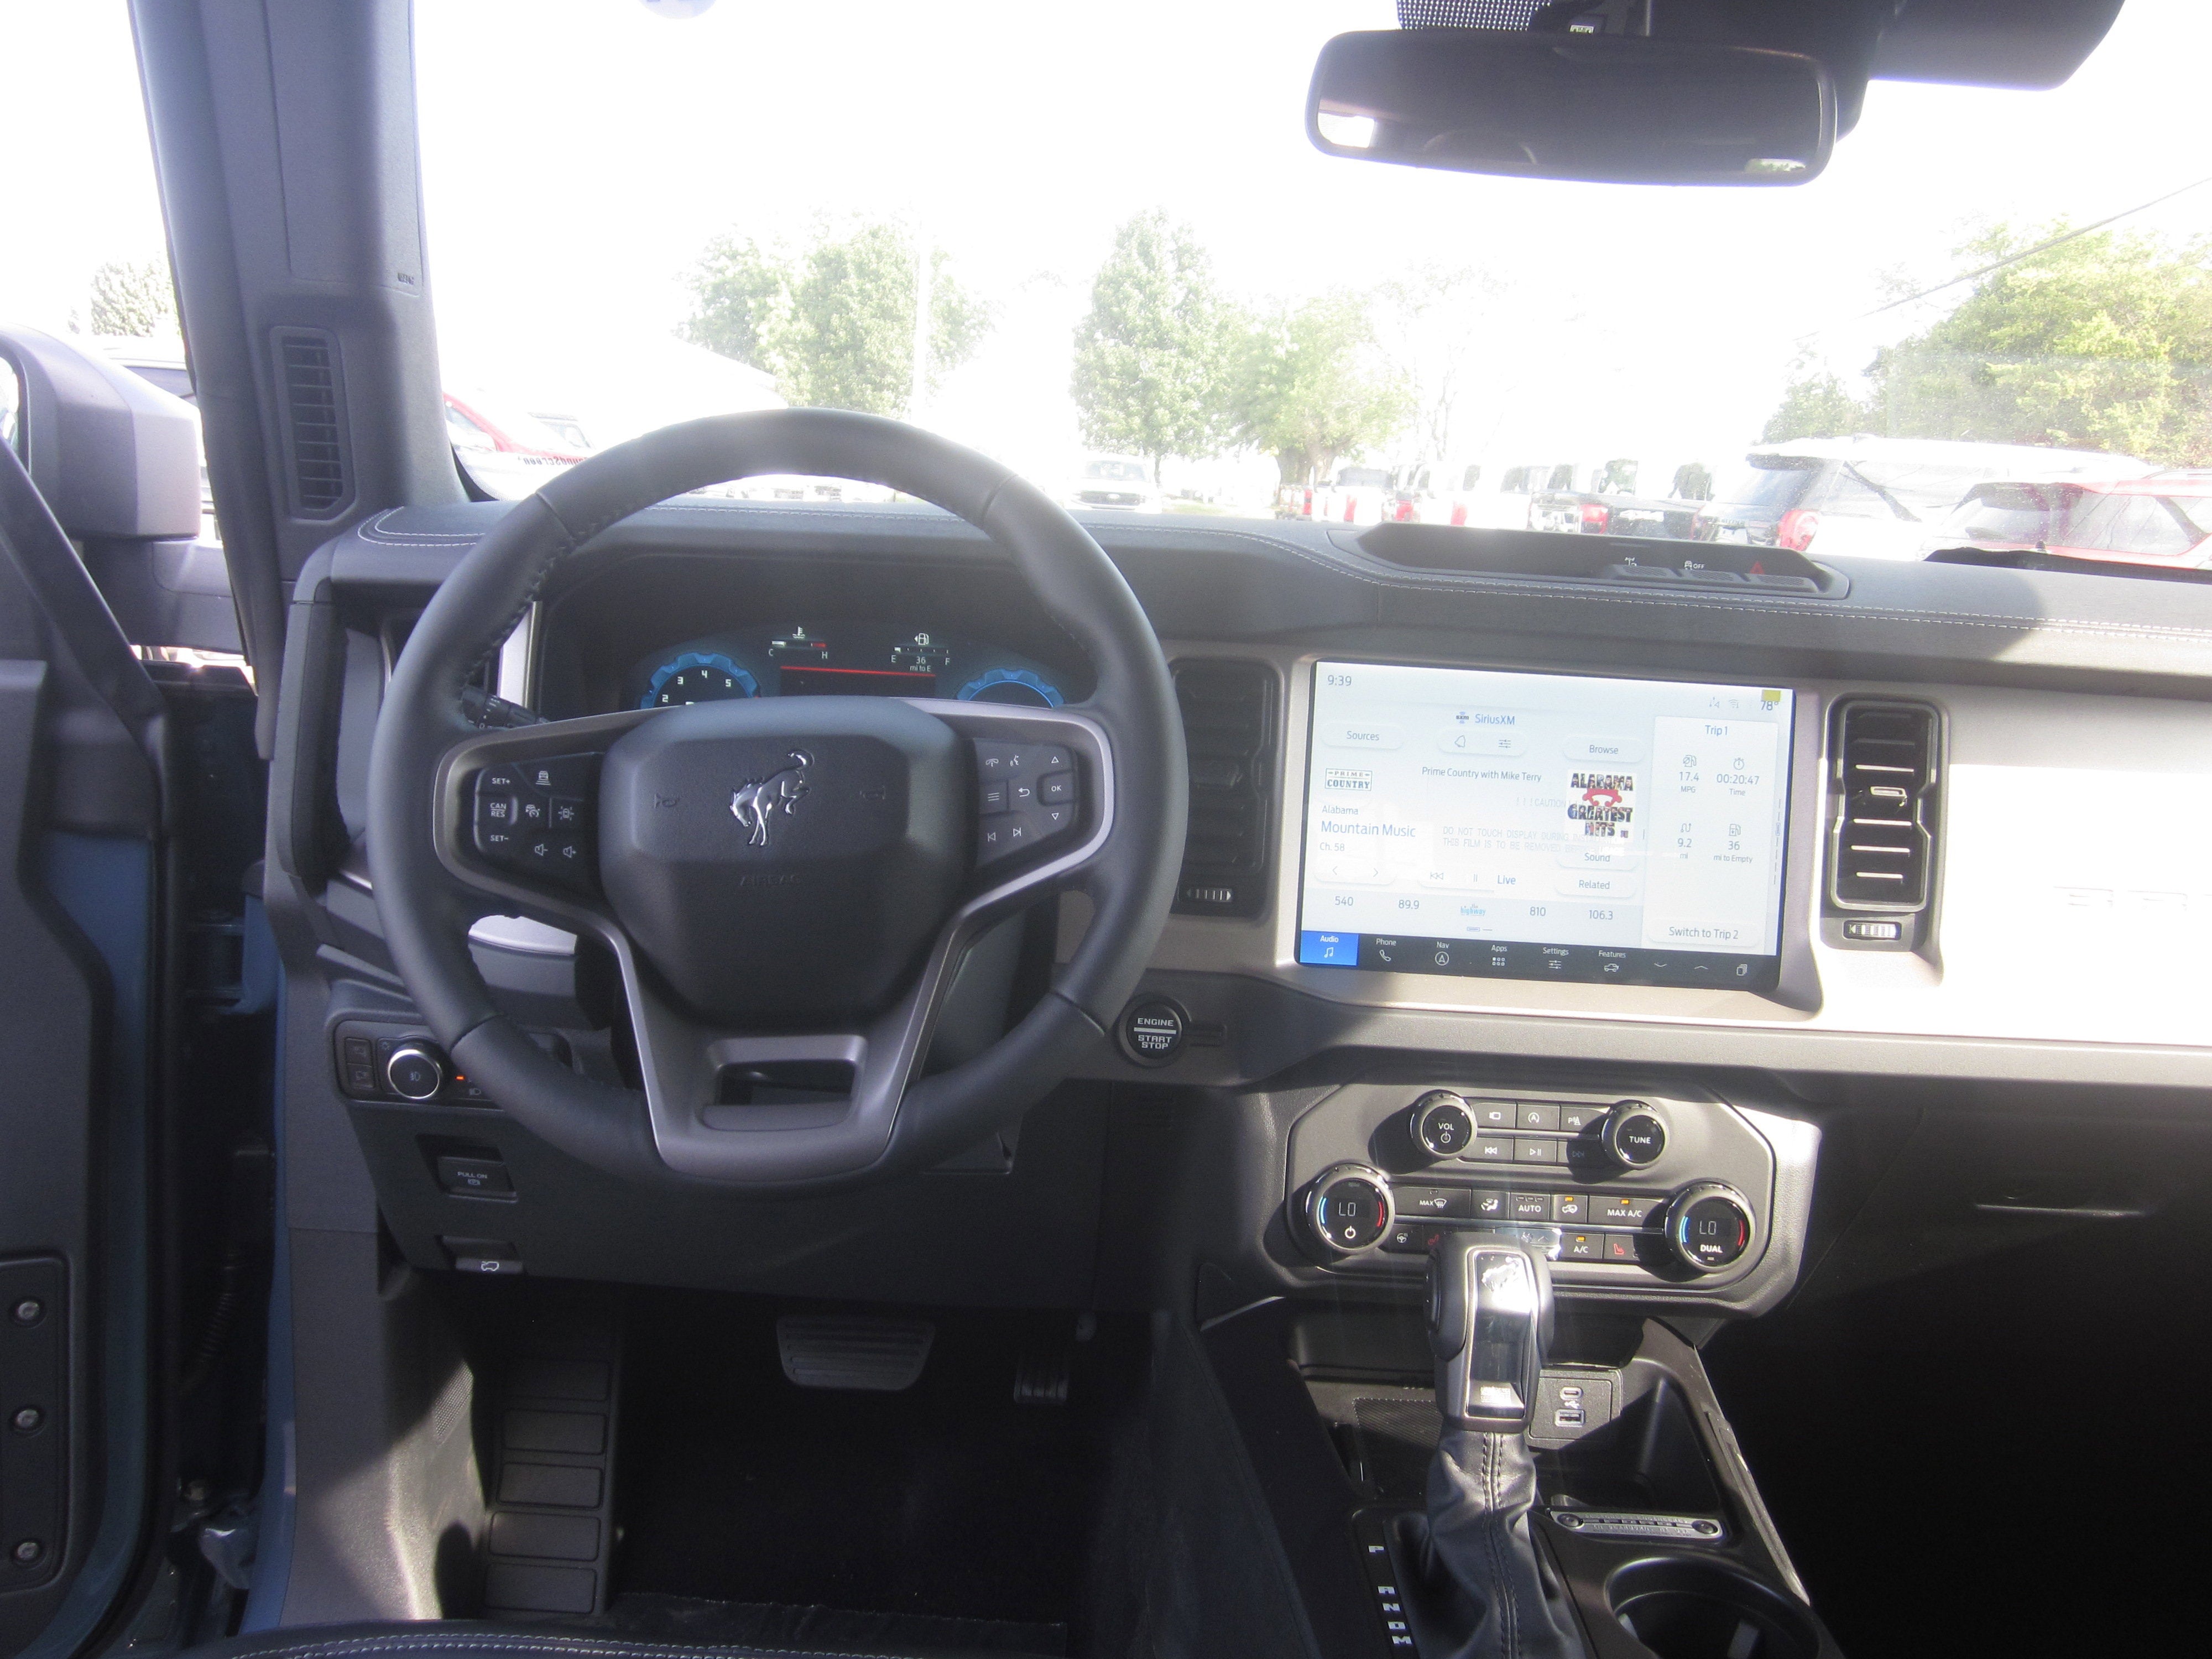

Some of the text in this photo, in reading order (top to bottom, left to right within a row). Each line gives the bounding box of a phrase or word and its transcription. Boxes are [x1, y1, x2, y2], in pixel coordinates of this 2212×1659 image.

[891, 655, 896, 663] E
[701, 670, 708, 679] 4
[677, 677, 684, 685] 3
[1327, 675, 1352, 686] 9:39
[661, 695, 669, 703] 2
[1475, 713, 1516, 725] SiriusXM
[1705, 725, 1728, 736] Trip 1
[1346, 731, 1380, 742] Sources
[1589, 744, 1619, 755] Browse
[1422, 766, 1542, 783] Prime Country with Mike Terry
[1679, 772, 1700, 782] 17.4
[1716, 774, 1760, 785] 00:20:47
[1327, 779, 1370, 790] COUNTRY
[1571, 773, 1634, 791] ALABAMA
[1322, 805, 1359, 816] Alabama
[1567, 804, 1634, 822] GREATEST
[1321, 821, 1416, 838] Mountain Music
[1443, 826, 1454, 835] DO
[1458, 827, 1474, 836] NOT
[1477, 828, 1503, 838] TOUCH
[1506, 830, 1537, 839] DISPLAY
[1319, 842, 1345, 852] Ch. 58
[1443, 837, 1459, 847] THIS
[1463, 838, 1480, 848] FILM
[1484, 839, 1491, 848] IS
[1496, 840, 1506, 849] TO
[1510, 841, 1521, 851] BE
[1524, 842, 1561, 852] REMOVED
[1677, 838, 1692, 848] 9.2
[1728, 841, 1740, 851] 36
[1584, 853, 1611, 863] Sound
[1731, 855, 1753, 864] Empty
[1497, 875, 1516, 885] Live
[1578, 880, 1610, 890] Related
[1334, 896, 1354, 906] 540
[1398, 900, 1420, 910] 89.9
[1530, 906, 1547, 917] 810
[1589, 910, 1614, 920] 106.3
[1668, 926, 1739, 941] Switch to Trip 2
[1320, 935, 1339, 943] Audio
[1376, 938, 1397, 947] Phone
[1437, 942, 1449, 950] Nav
[1491, 945, 1507, 953] Apps
[1542, 947, 1569, 957] Settings
[1598, 950, 1626, 959] Features
[1137, 1018, 1173, 1026] ENGINE
[1138, 1035, 1172, 1043] START
[1438, 1123, 1454, 1131] VOL
[1629, 1136, 1652, 1145] TUNE
[1518, 1204, 1542, 1213] AUTO
[1607, 1209, 1642, 1218] MAX A/C
[1573, 1245, 1589, 1254] A/C
[1700, 1244, 1723, 1254] DUAL
[1368, 1545, 1385, 1553] P
[1383, 1603, 1401, 1612] N
[1387, 1621, 1406, 1630] D
[1391, 1635, 1412, 1645] M
